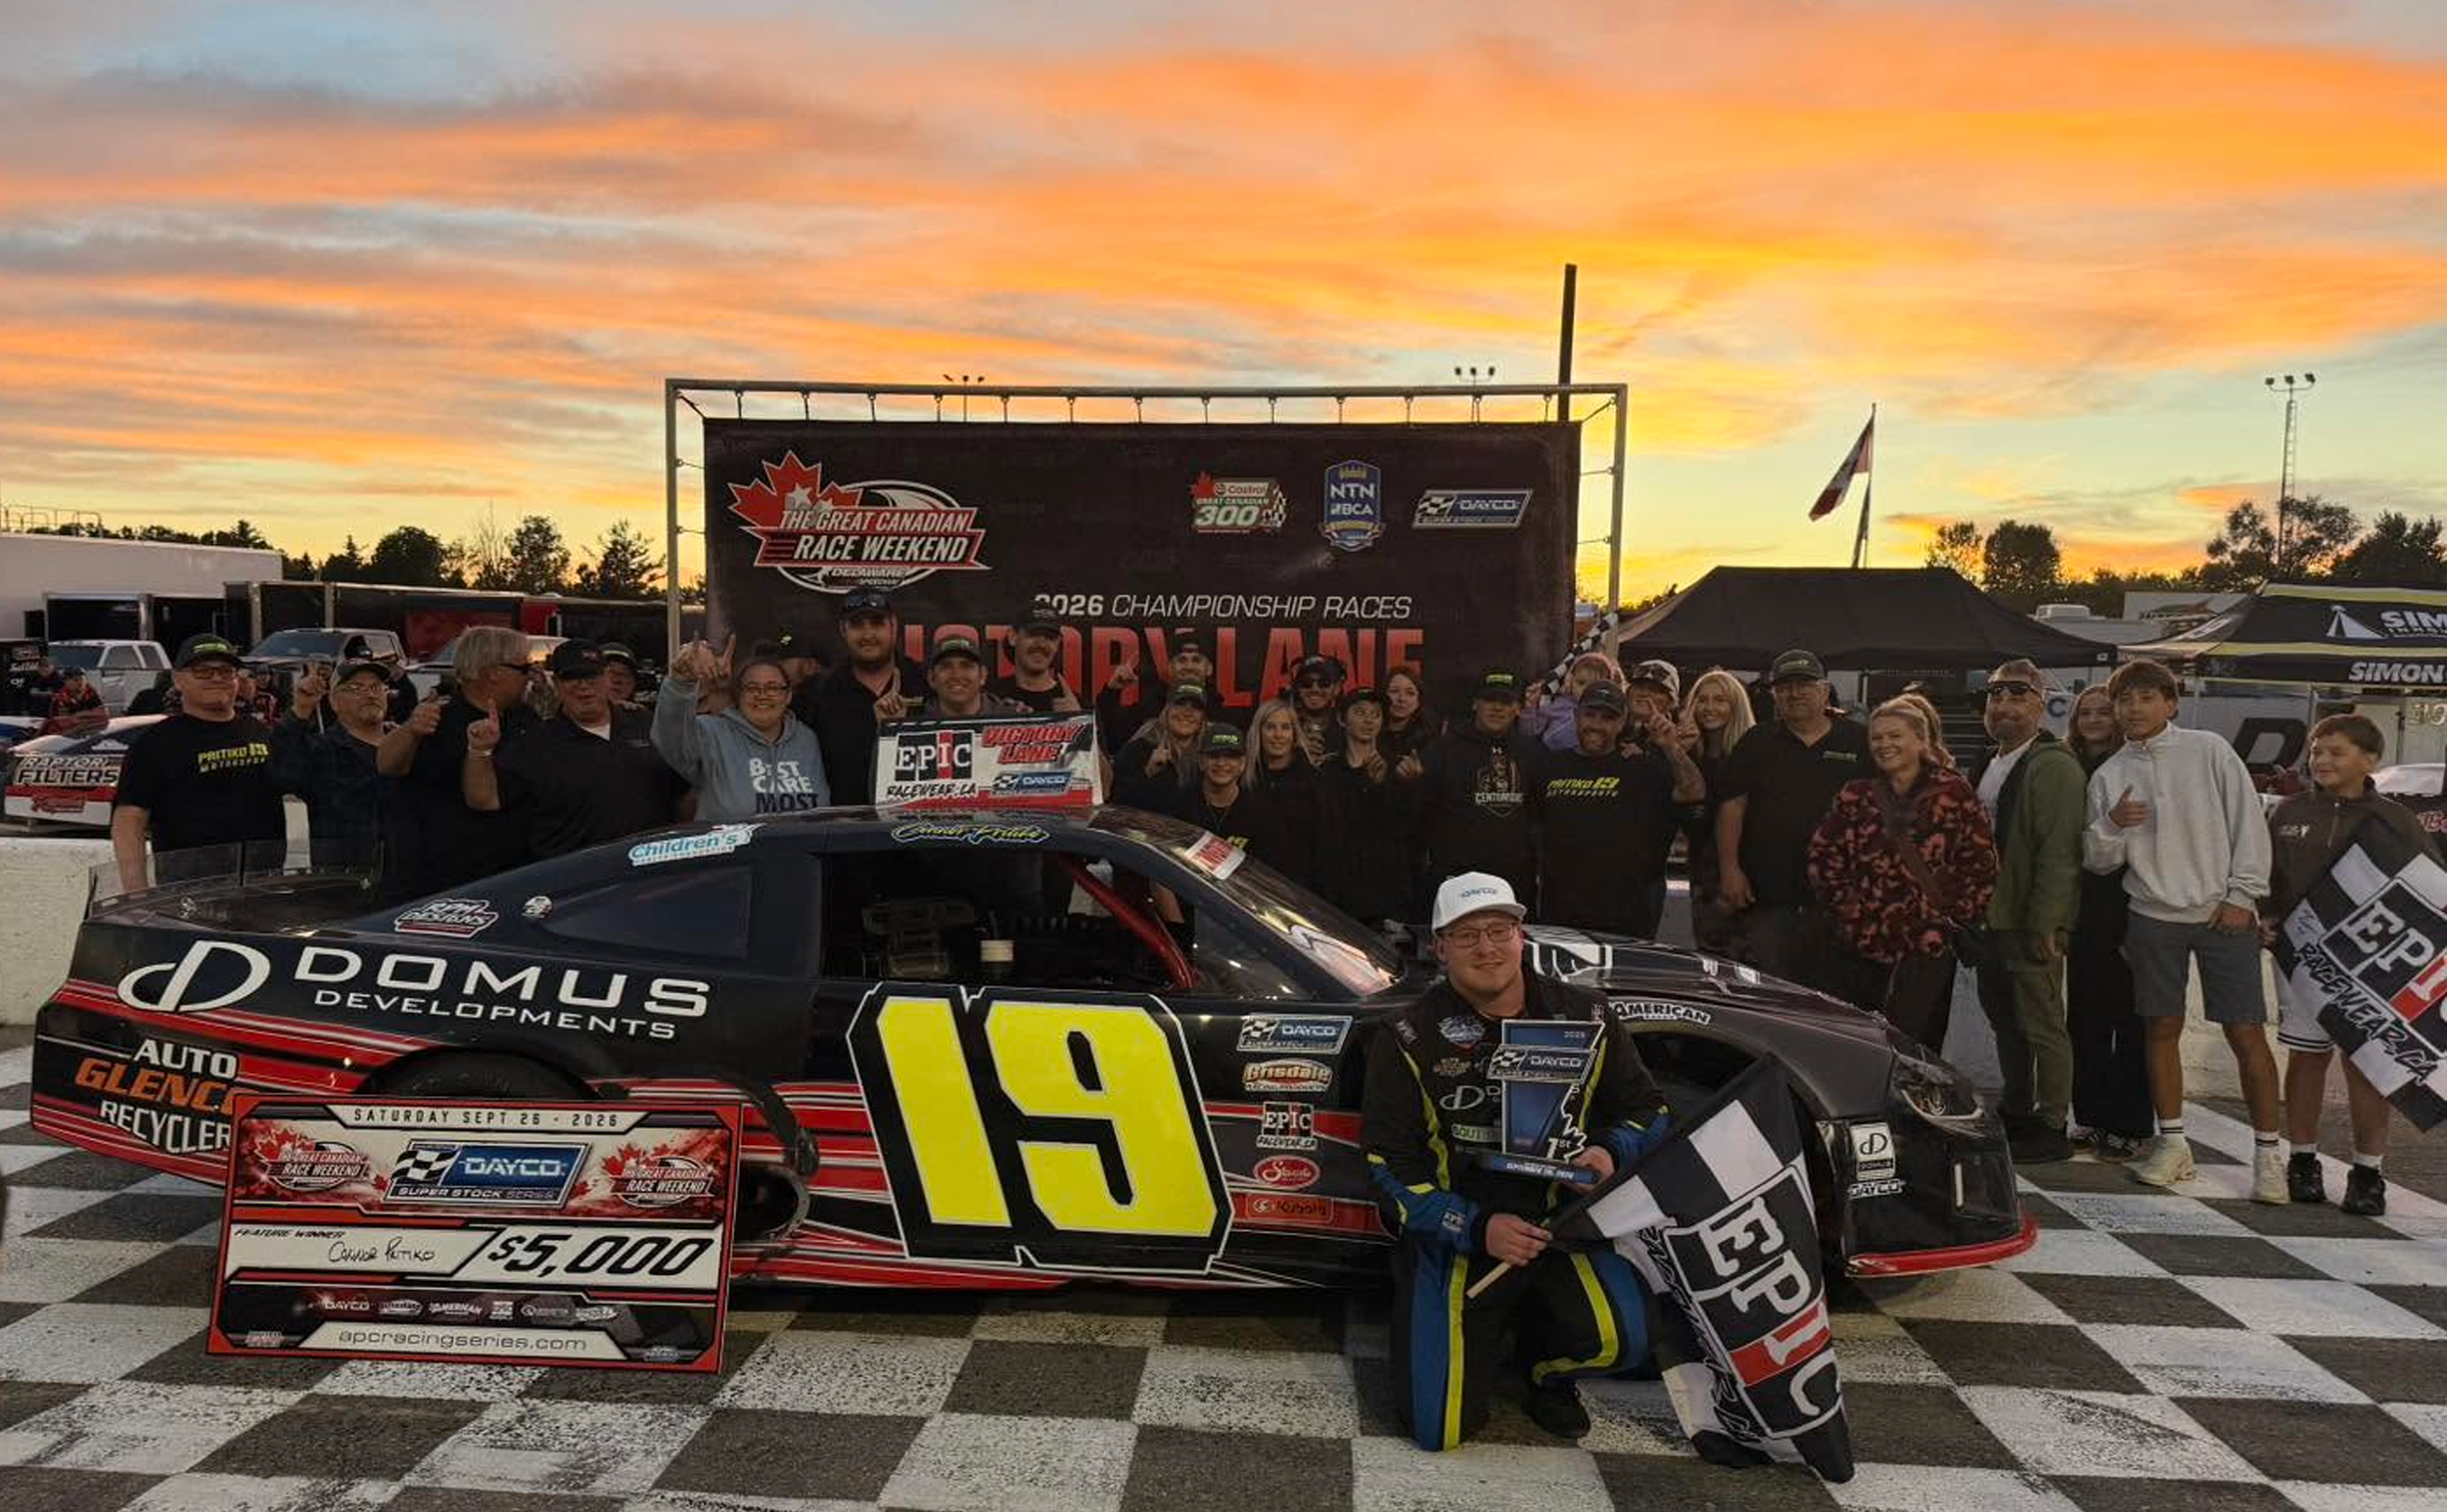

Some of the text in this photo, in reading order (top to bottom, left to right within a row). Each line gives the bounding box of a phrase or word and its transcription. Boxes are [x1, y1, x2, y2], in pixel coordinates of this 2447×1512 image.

[1330, 483, 1374, 499] NTN
[1342, 503, 1373, 516] BCA
[1459, 499, 1518, 511] DAYCO
[782, 511, 967, 532] THE GREAT CANADIAN
[1195, 505, 1260, 527] 300
[793, 534, 969, 562] RACE WEEKEND
[831, 567, 906, 577] DELAWARE
[1112, 593, 1316, 620] CHAMPIONSHIP
[1323, 595, 1412, 620] RACES
[982, 724, 1083, 748] VICTORY
[23, 756, 106, 767] RAPTOR
[895, 743, 971, 771] EPIC
[998, 742, 1061, 764] LANE
[18, 768, 119, 784] FILTERS
[1022, 776, 1066, 785] DAYCO
[755, 792, 819, 813] MOST
[631, 832, 738, 858] Children's
[2340, 899, 2447, 1026] EPI
[294, 946, 711, 1018] DOMUS
[313, 989, 675, 1040] DEVELOPMENTS
[1612, 1002, 1711, 1025] AMERICAN
[1282, 1025, 1336, 1036] DAYCO
[133, 1038, 238, 1079] AUTO
[1530, 1055, 1582, 1068] DAYCO
[1244, 1064, 1332, 1084] Grisdale
[353, 1108, 449, 1123] SATURDAY
[463, 1111, 507, 1124] SEPT
[520, 1112, 541, 1125] 26
[572, 1114, 619, 1126] 2026
[878, 995, 1218, 1238] 19
[1264, 1111, 1312, 1129] EPIC
[283, 1162, 360, 1177] RACE WEEKEND
[464, 1156, 563, 1177] DAYCO
[397, 1186, 554, 1201] SUPER STOCK SERIES
[626, 1179, 708, 1195] RACE WEEKEND
[234, 1228, 346, 1239] FEATURE WINNER
[487, 1234, 716, 1278] $5,000
[325, 1301, 371, 1311] DAYCO
[1698, 1196, 1840, 1416] EPIC
[339, 1329, 587, 1352] apcracingseries.com
